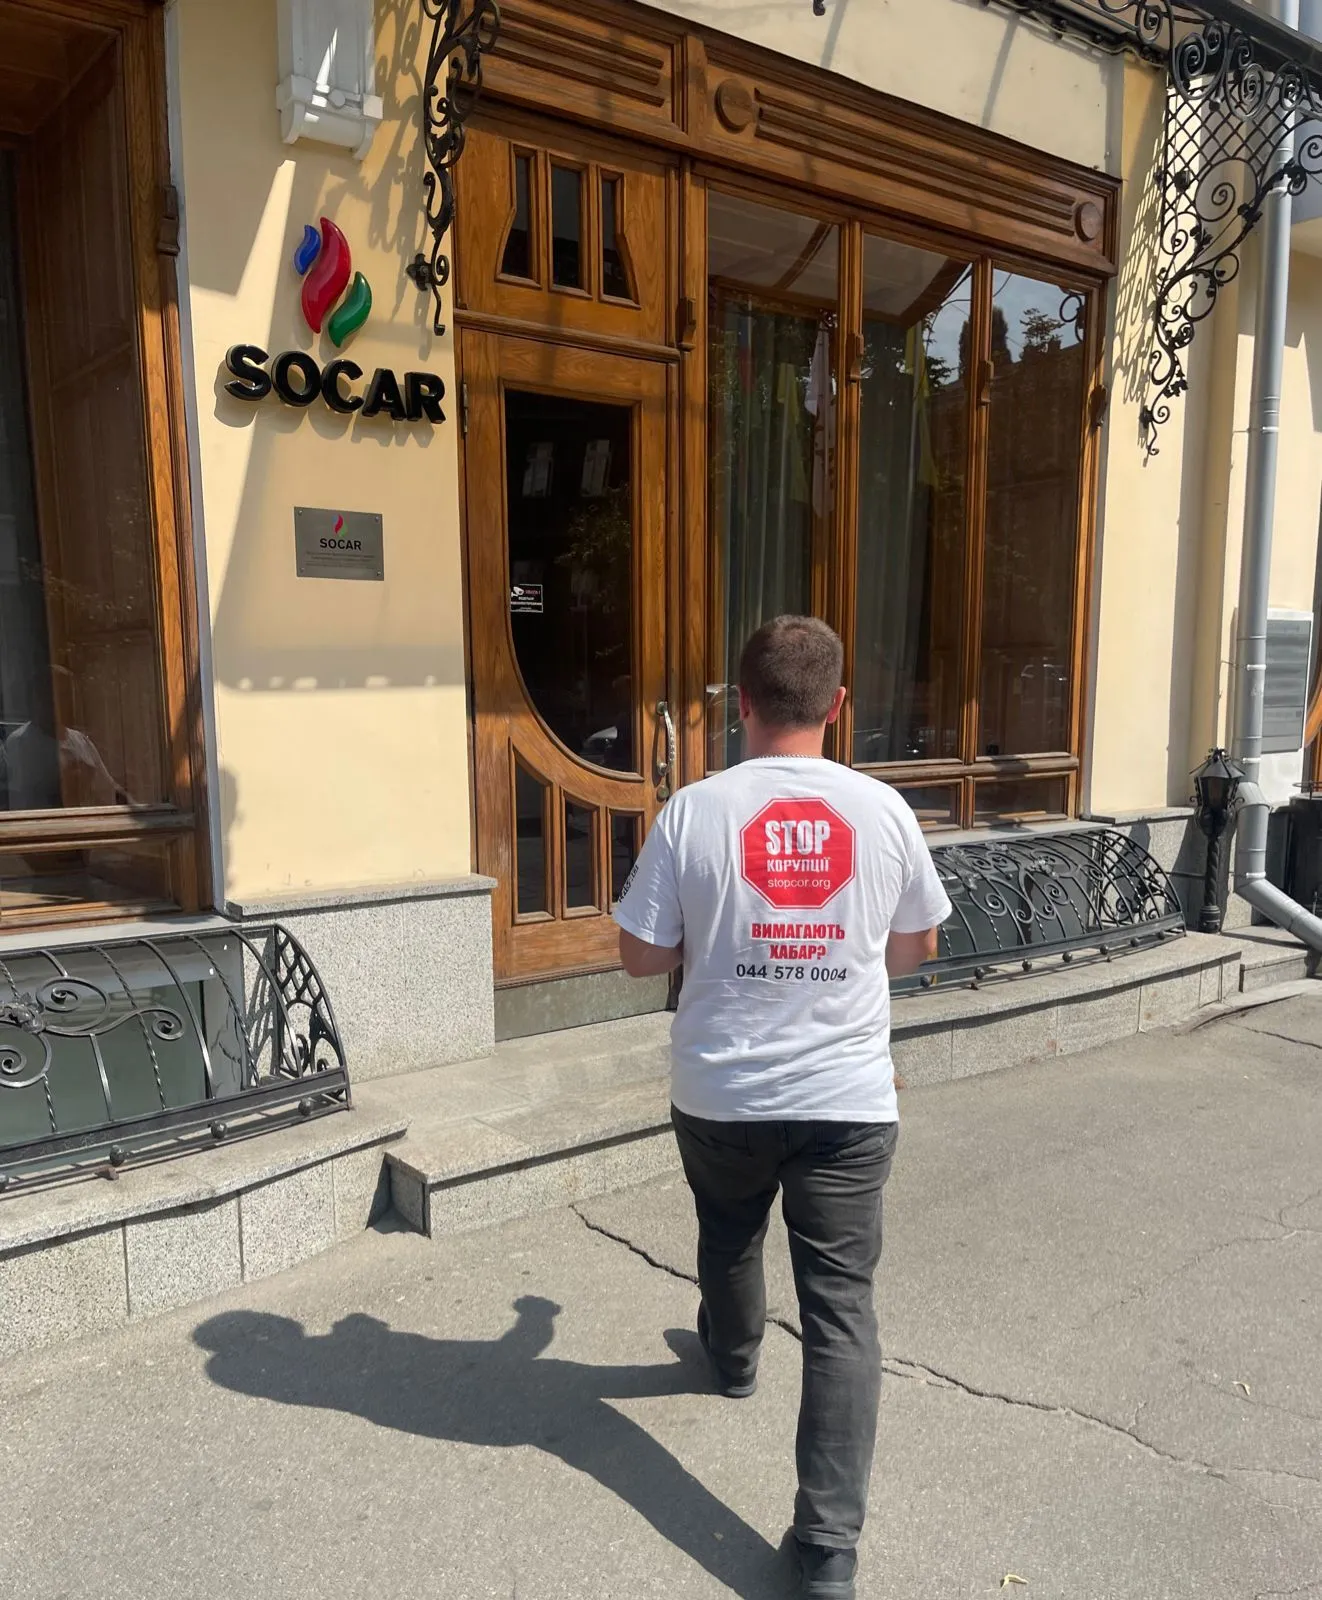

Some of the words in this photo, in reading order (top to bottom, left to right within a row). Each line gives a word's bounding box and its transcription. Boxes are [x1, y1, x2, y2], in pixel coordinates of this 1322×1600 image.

[223, 343, 447, 424] SOCAR
[319, 538, 362, 551] SOCAR
[765, 820, 831, 855] STOP
[767, 857, 831, 873] КОРУПЦІЇ
[767, 878, 831, 890] stopcor.org
[751, 923, 846, 940] ВИМАГАЮТЬ
[769, 944, 827, 960] ХАБАР?
[736, 964, 768, 978] 044
[774, 966, 805, 980] 578
[810, 967, 847, 982] 0004
